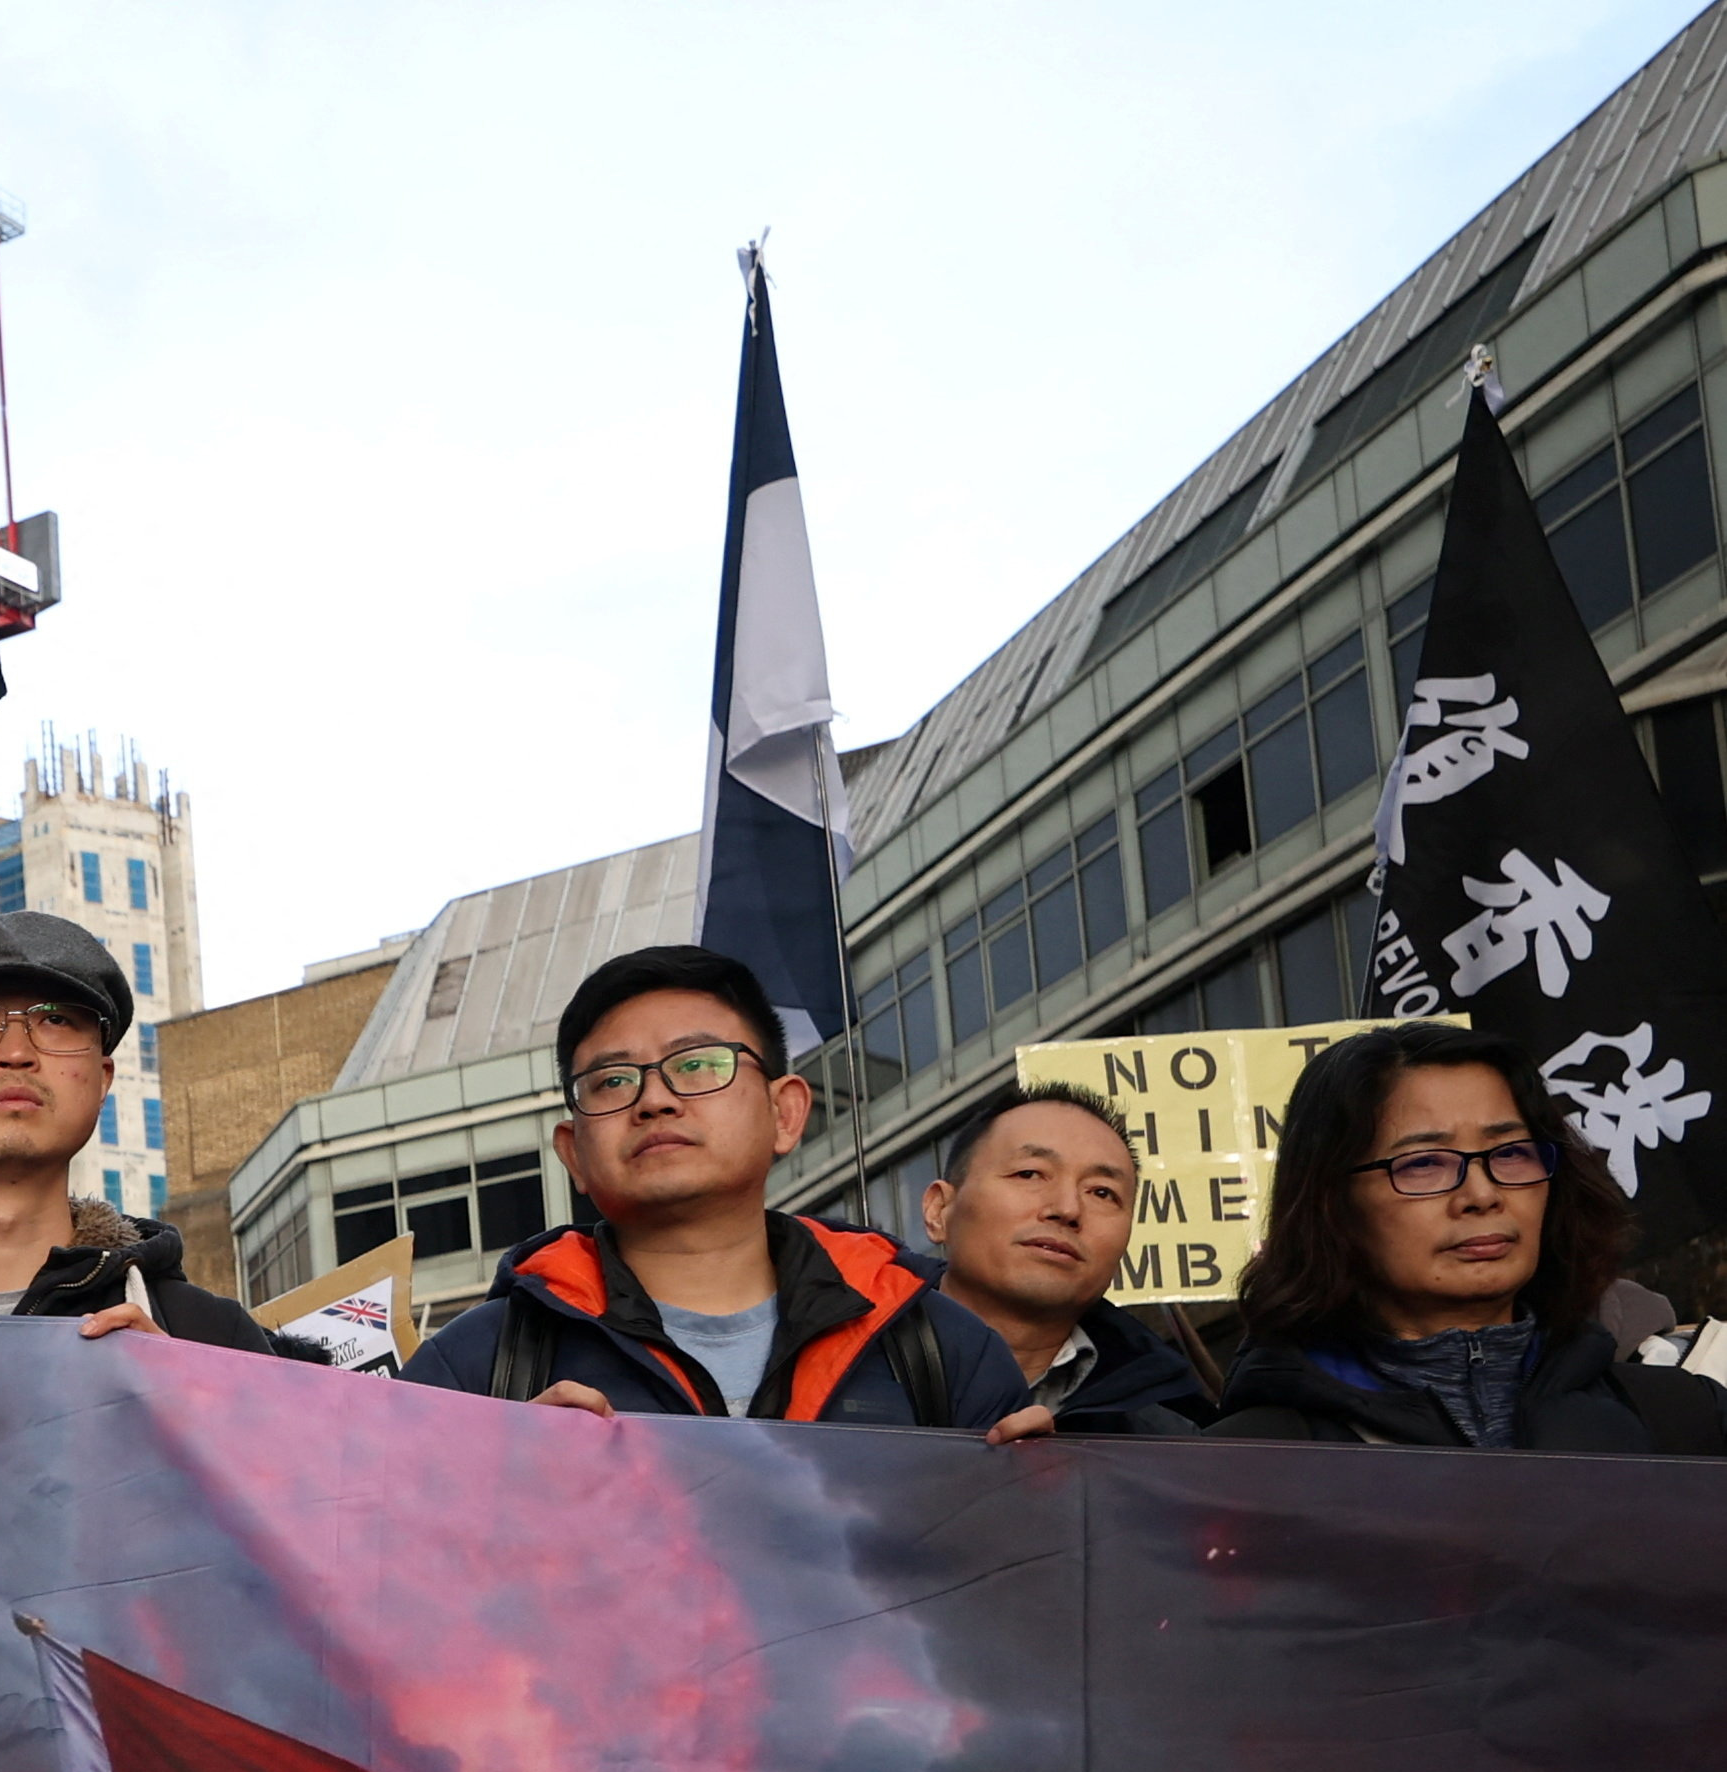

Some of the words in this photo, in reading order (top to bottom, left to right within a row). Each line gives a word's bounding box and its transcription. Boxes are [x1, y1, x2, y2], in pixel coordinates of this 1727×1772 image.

[1374, 908, 1450, 1018] REVO
[1103, 1047, 1217, 1096] NO
[1119, 1103, 1290, 1155] HIN
[1138, 1176, 1250, 1223] ME
[1113, 1243, 1223, 1291] MB
